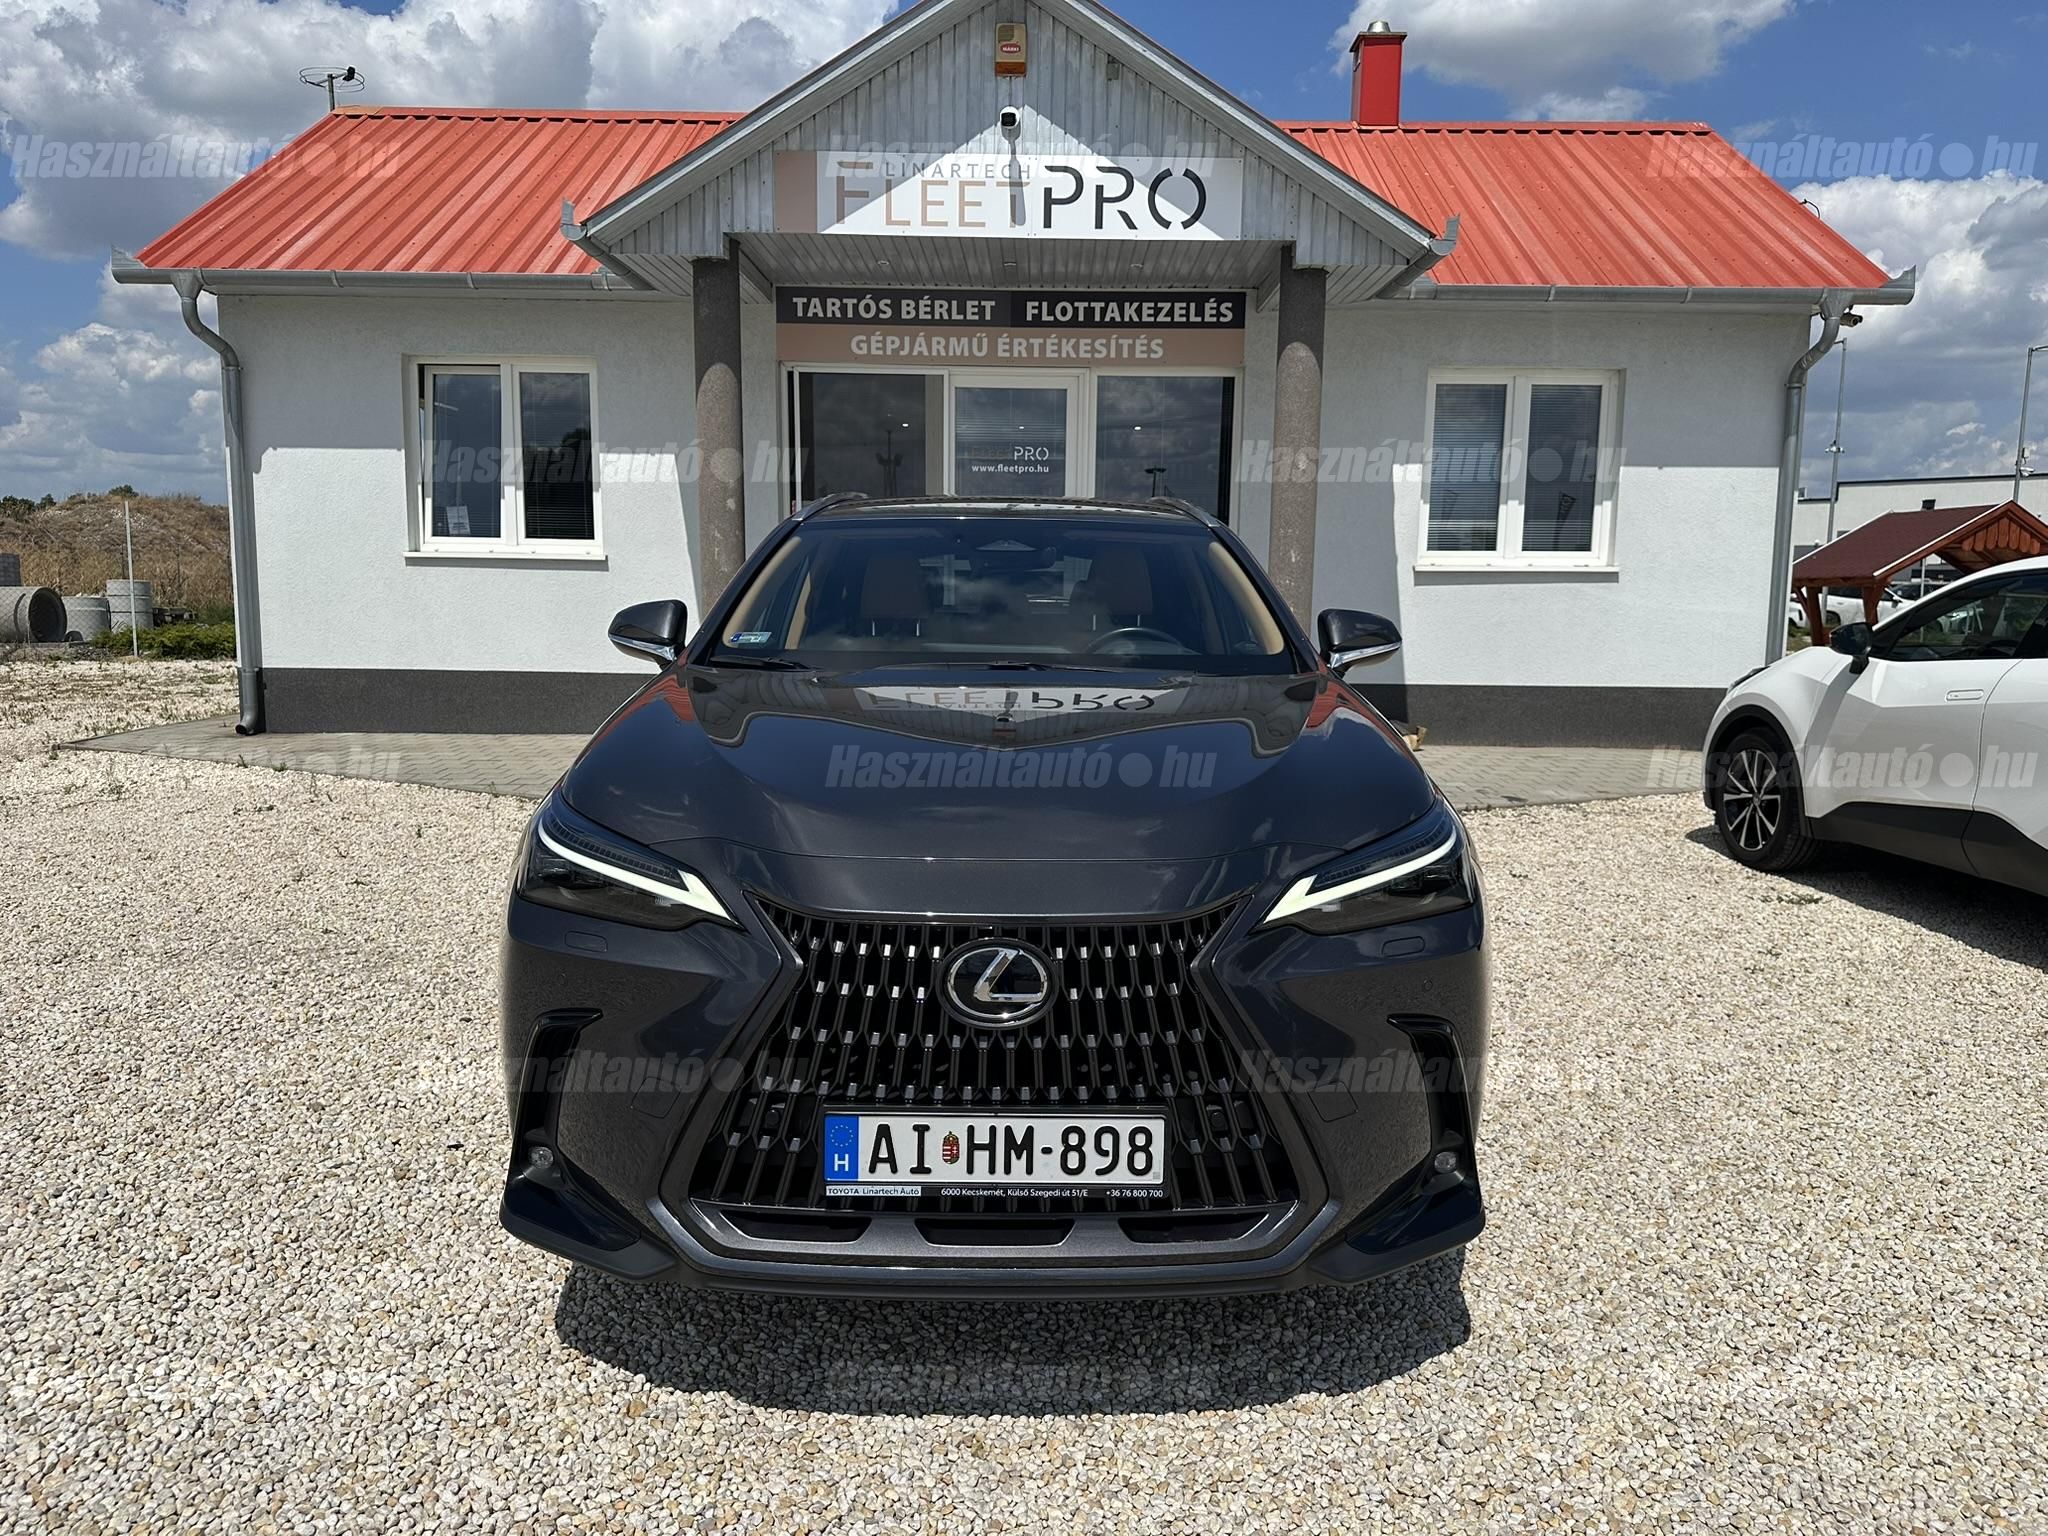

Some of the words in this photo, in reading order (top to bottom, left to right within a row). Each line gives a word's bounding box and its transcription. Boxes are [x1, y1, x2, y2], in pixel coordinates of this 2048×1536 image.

[885, 161, 1031, 179] LINARTECH
[836, 160, 1031, 229] FLEET
[1043, 164, 1208, 231] PRO
[792, 294, 893, 320] TARTÓS
[901, 294, 996, 322] BÉRLET
[1026, 297, 1234, 324] FLOTTAKEZELÉS
[850, 331, 988, 359] GÉPJÁRMŰ
[998, 332, 1164, 360] ÉRTÉKESÍTÉS
[1014, 446, 1049, 461] PRO
[971, 463, 1049, 474] www.fleetpro.hu
[834, 1153, 849, 1172] H
[862, 1187, 899, 1195] Linartech
[941, 1188, 961, 1196] 6000
[962, 1188, 1006, 1197] Kecskemét,
[1030, 1188, 1061, 1198] Szegedi
[1071, 1189, 1089, 1197] 51/E
[1106, 1189, 1121, 1197] +36
[1121, 1189, 1132, 1197] 76
[1132, 1189, 1148, 1197] 800
[1149, 1189, 1164, 1197] 700
